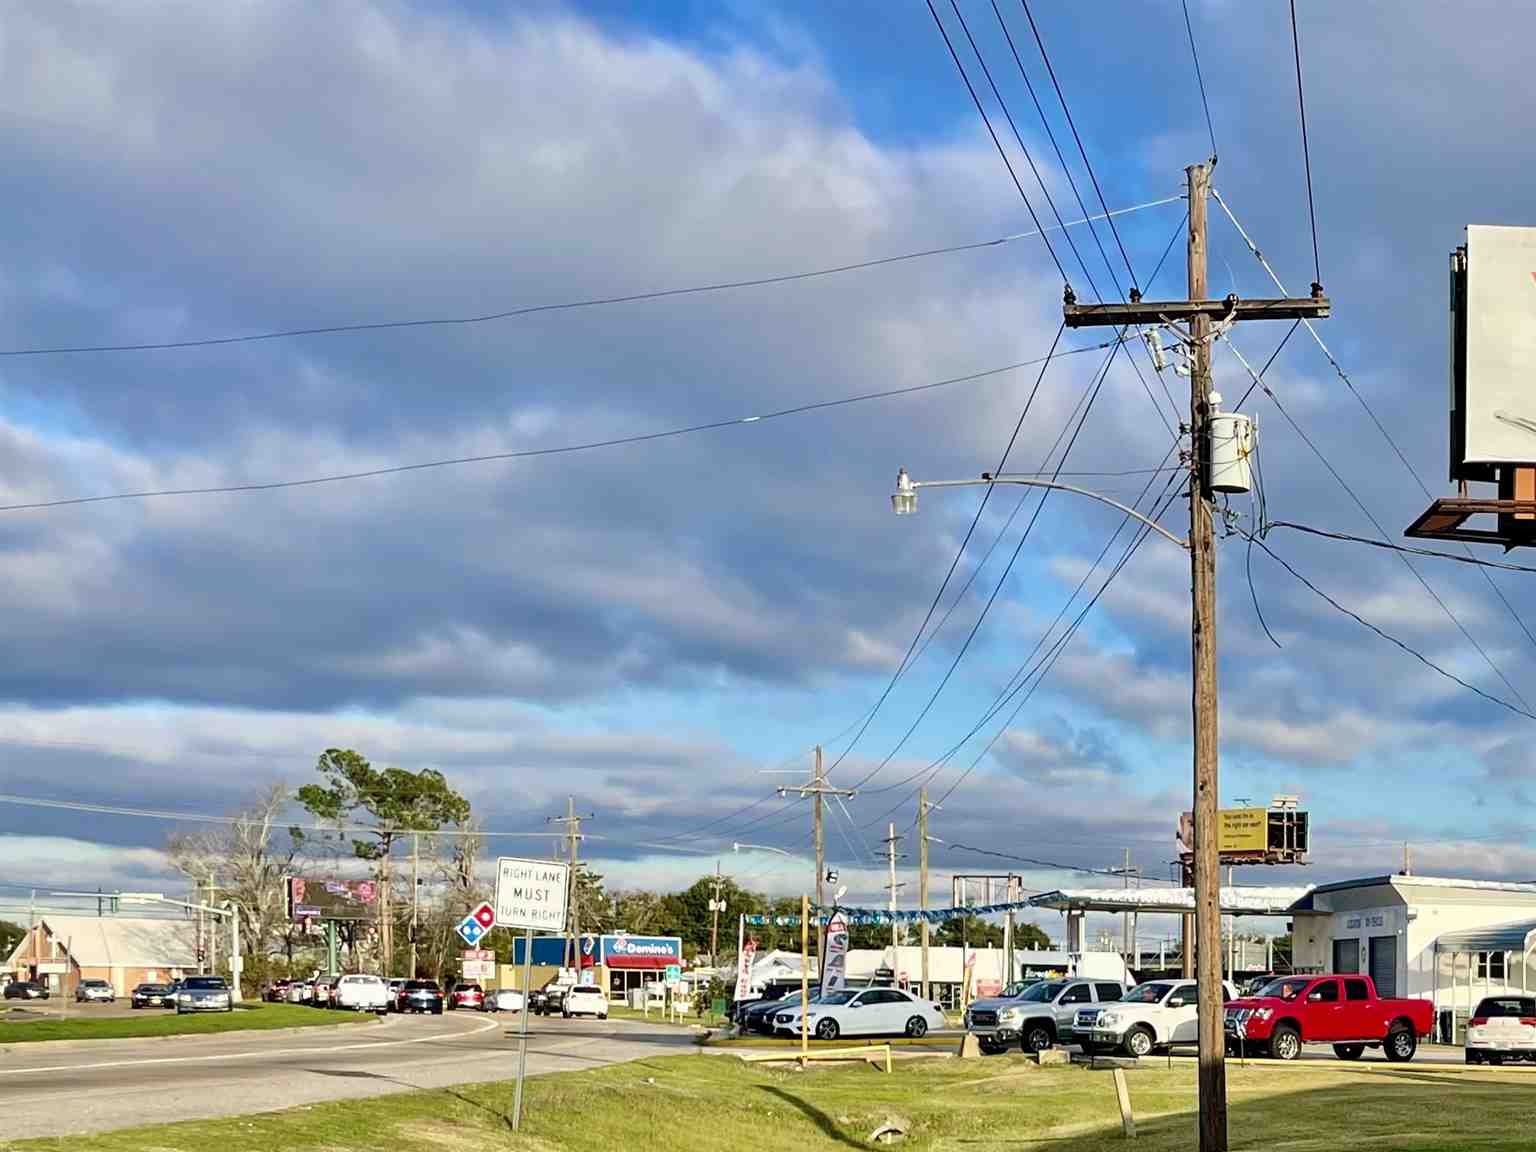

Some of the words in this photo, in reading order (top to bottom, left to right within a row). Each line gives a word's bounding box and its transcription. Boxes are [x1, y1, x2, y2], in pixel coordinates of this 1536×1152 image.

[503, 867, 532, 880] RIGHT
[535, 870, 561, 883] LANE
[513, 887, 550, 902] MUST
[501, 905, 527, 918] TURN
[531, 909, 561, 921] RIGHT
